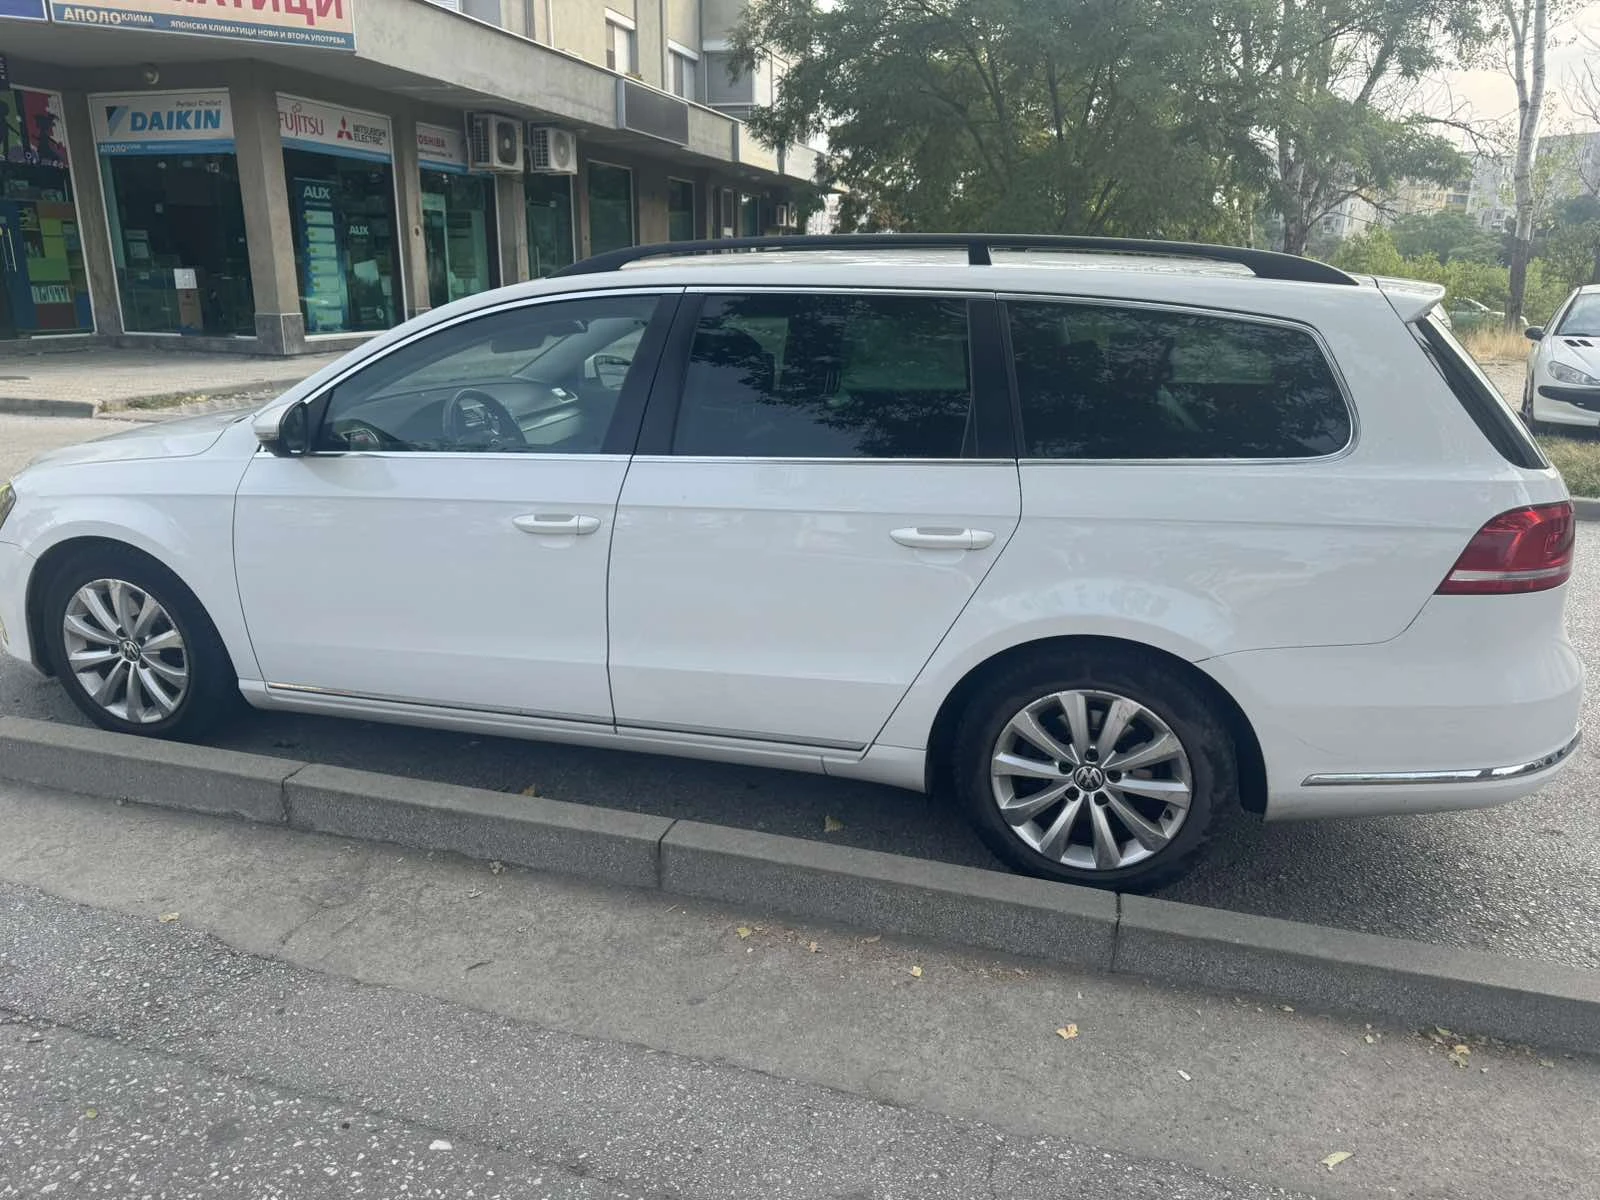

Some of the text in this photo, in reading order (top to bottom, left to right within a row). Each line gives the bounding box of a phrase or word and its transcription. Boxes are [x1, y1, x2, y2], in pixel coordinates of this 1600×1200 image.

[170, 20, 208, 31] ЯПОНСКИ
[208, 25, 257, 36] КЛИМАТИЦИ
[258, 29, 279, 38] НОВИ
[287, 32, 311, 41] ВТОРА
[311, 35, 346, 45] УПОТРЕБА
[130, 109, 222, 132] DAIKIN
[303, 185, 331, 200] AUX
[349, 225, 369, 235] AUX
